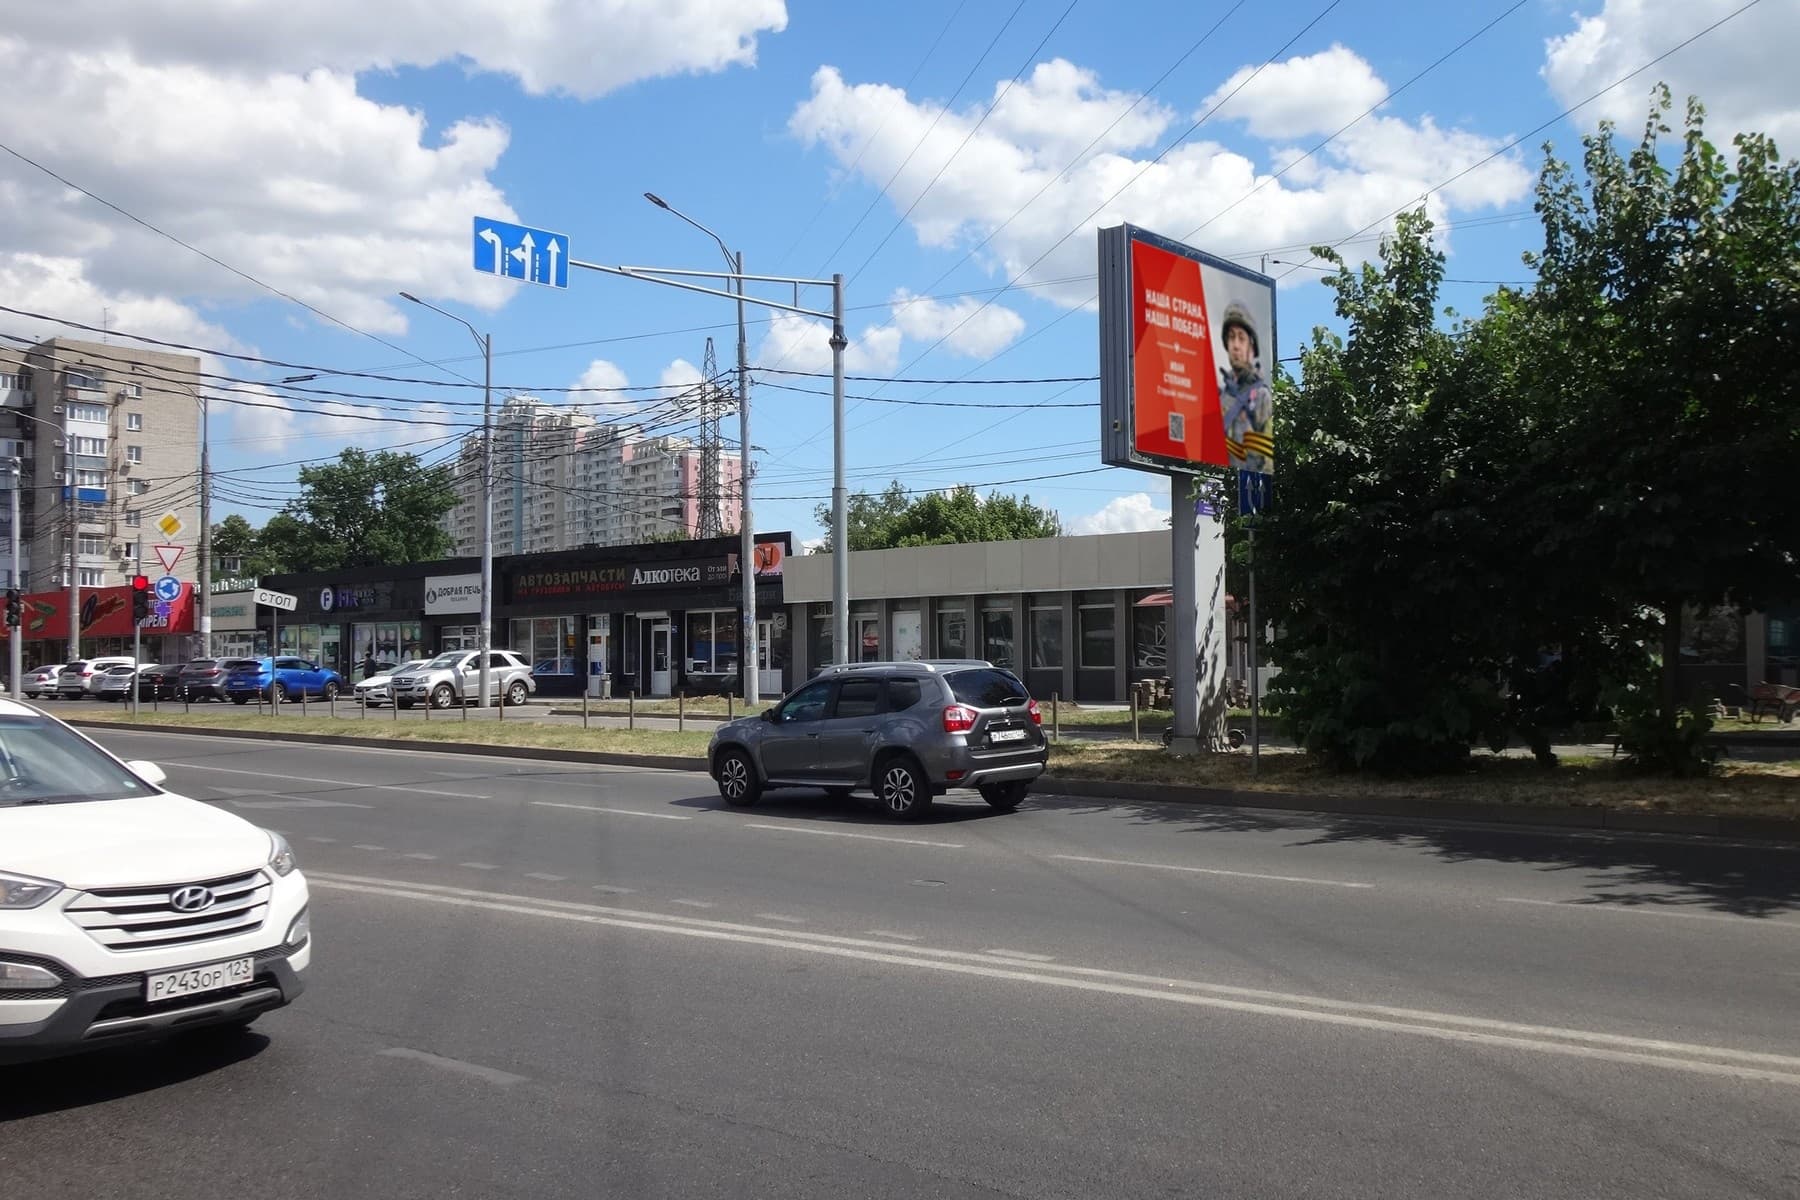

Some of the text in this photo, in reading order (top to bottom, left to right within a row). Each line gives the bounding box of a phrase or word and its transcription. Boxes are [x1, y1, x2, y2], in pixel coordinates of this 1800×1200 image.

[1145, 288, 1170, 310] НАША
[1145, 307, 1170, 329] НАША
[519, 568, 625, 587] АВТОЗАПЧАСТИ
[260, 592, 291, 607] СТОП
[438, 586, 462, 597] ДОБРАЯ
[154, 960, 250, 997] Р243ОР 123
